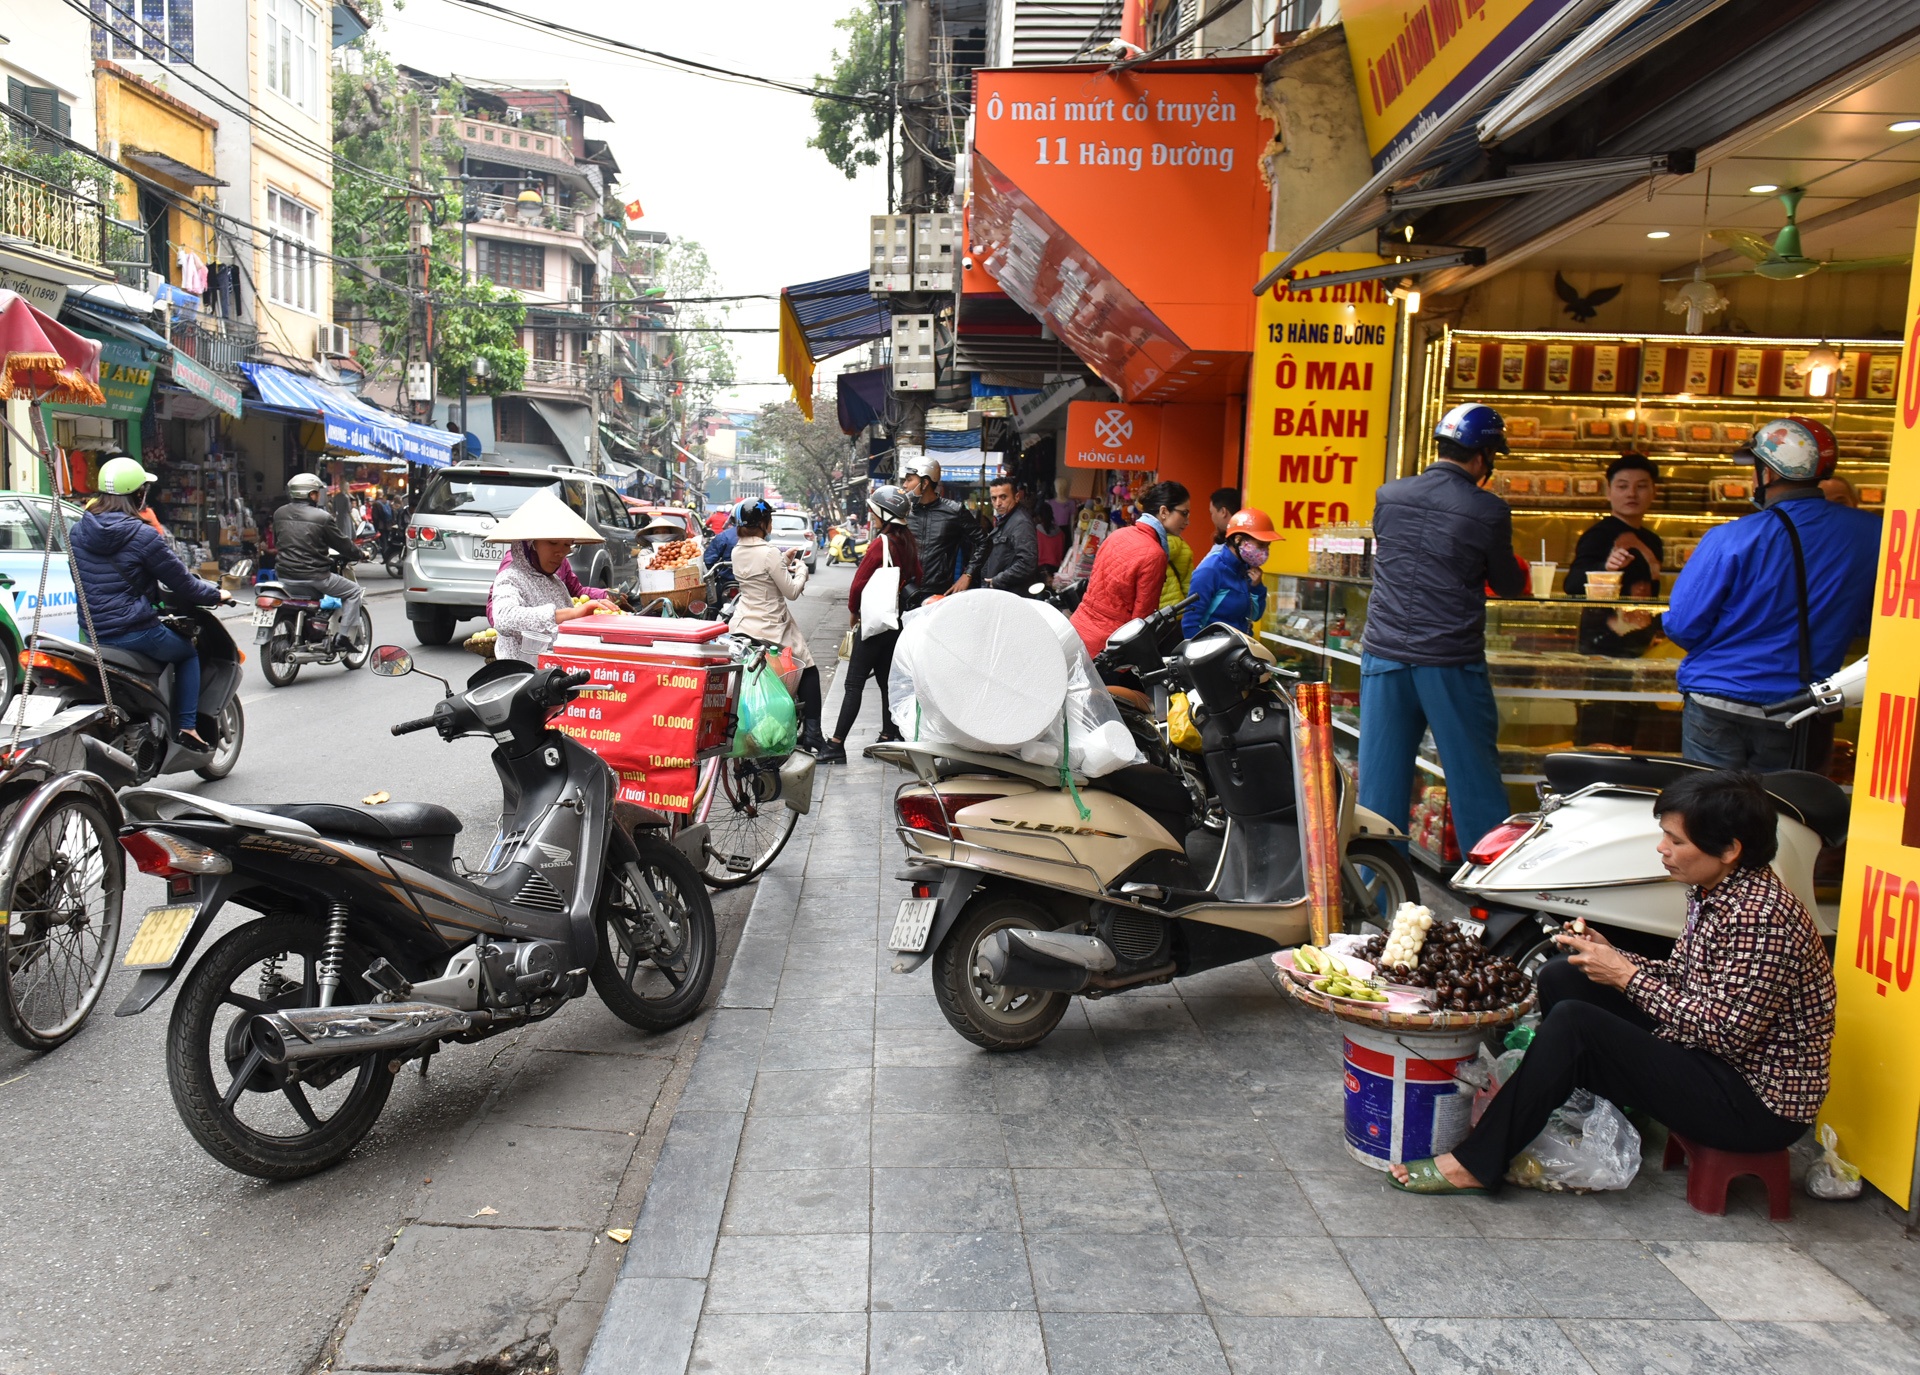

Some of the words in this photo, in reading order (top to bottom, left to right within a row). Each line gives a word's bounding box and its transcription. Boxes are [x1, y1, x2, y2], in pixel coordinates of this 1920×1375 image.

[987, 91, 1004, 121] Ô
[1011, 96, 1057, 121] mai
[1064, 93, 1115, 122] mứt
[1122, 90, 1149, 122] cổ
[1156, 90, 1236, 127] truyền
[1035, 137, 1070, 165] 11
[1079, 139, 1143, 171] Hàng
[1151, 141, 1235, 172] Đường
[32, 286, 58, 303] (1898)
[1268, 323, 1284, 343] 13
[1288, 319, 1329, 343] HÀNG
[111, 364, 151, 387] ANH
[1275, 353, 1297, 390] Ô
[1305, 361, 1373, 391] MAI
[1273, 400, 1368, 438] BÁNH
[1118, 454, 1145, 464] LAM
[1279, 446, 1358, 484] MỨT
[473, 549, 503, 559] 043.02
[28, 591, 77, 609] DAIKIN
[594, 667, 620, 682] đánh
[622, 669, 636, 683] đá
[656, 674, 698, 690] 15.000đ
[596, 689, 627, 703] shake
[567, 705, 586, 719] đen
[589, 707, 602, 720] đá
[652, 714, 694, 730] 10.000đ
[590, 729, 621, 743] coffee
[649, 754, 691, 769] 10.000đ
[623, 770, 646, 783] milk
[626, 786, 646, 802] tươi
[648, 791, 689, 808] 10.000đ
[540, 860, 574, 869] HONDA
[1534, 891, 1590, 907] Sprint
[1855, 865, 1920, 997] KẸO
